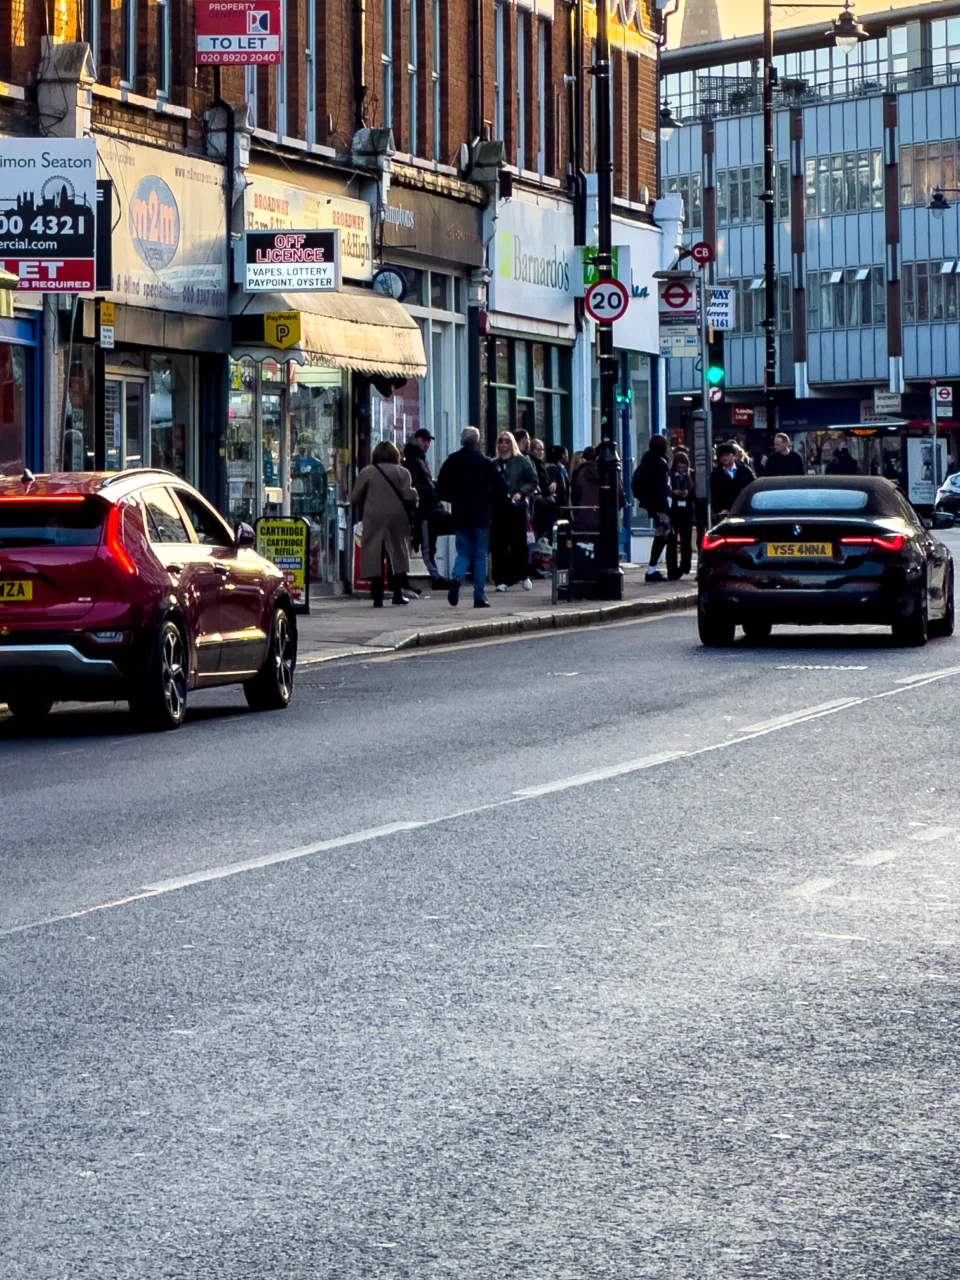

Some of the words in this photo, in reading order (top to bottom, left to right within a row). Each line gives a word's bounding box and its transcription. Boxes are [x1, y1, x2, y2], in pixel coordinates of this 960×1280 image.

[208, 3, 256, 11] PROPERTY
[209, 37, 232, 50] TO
[238, 37, 267, 49] LET
[200, 54, 220, 62] 020
[223, 54, 248, 62] 8920
[250, 53, 276, 62] 2040
[41, 151, 92, 168] Seaton
[253, 193, 289, 216] BROADWAY
[132, 190, 175, 245] m2m
[332, 210, 365, 232] BROADWAY
[383, 204, 415, 232] amptons
[30, 215, 85, 235] 4321
[274, 234, 306, 249] OFF
[256, 248, 325, 263] LICENCE
[694, 248, 709, 257] CB
[514, 234, 570, 292] Barnardo's
[253, 268, 284, 277] VAPES,
[287, 267, 328, 276] LOTTERY
[31, 281, 91, 289] REQUIRED
[124, 275, 140, 295] blind
[248, 279, 295, 288] PAYPOINT,
[297, 278, 333, 287] OYSTER
[592, 292, 622, 309] 20
[266, 314, 299, 322] PayPoint
[260, 526, 304, 537] CARTRIDGE
[266, 538, 304, 547] CARTRIDGE
[275, 547, 295, 556] REFILL
